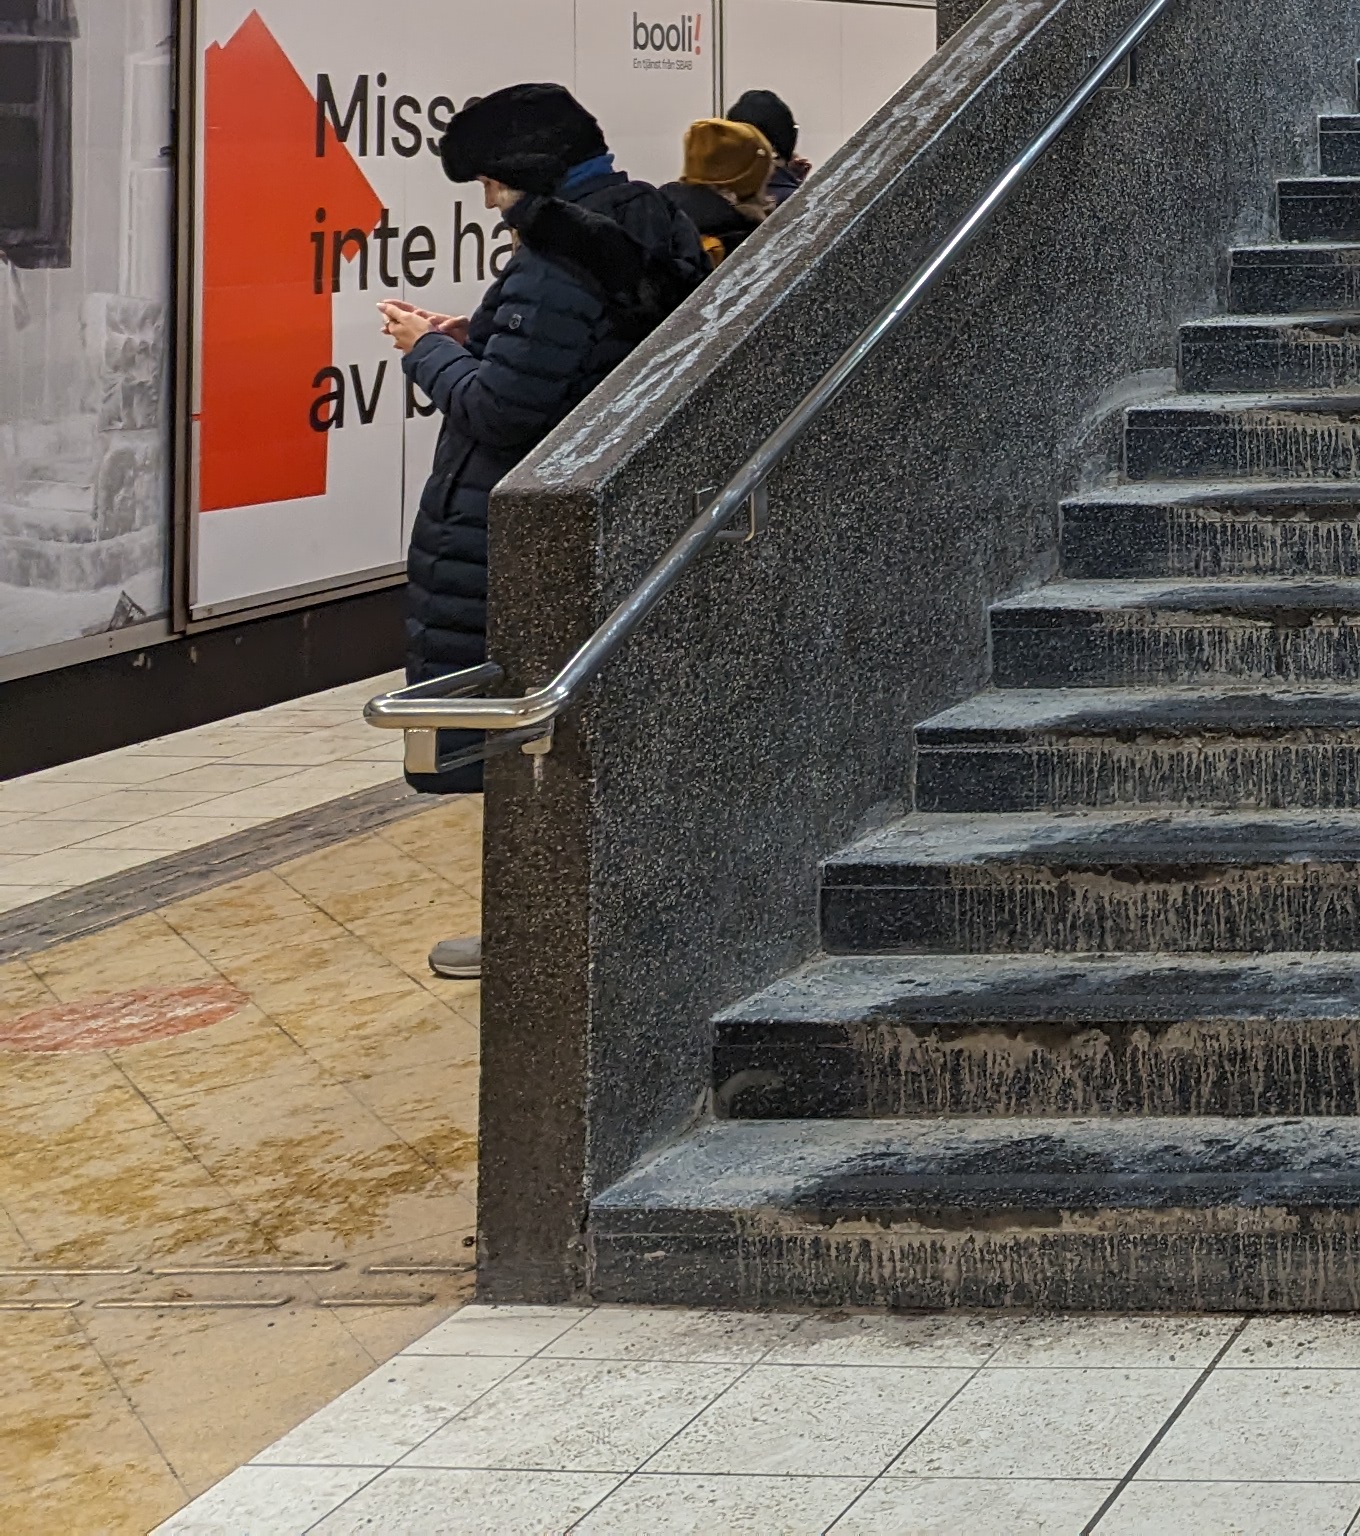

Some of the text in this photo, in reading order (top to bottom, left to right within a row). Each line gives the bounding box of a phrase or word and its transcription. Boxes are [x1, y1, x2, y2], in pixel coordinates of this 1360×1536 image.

[633, 11, 701, 56] booli!
[316, 72, 486, 157] Miss
[310, 206, 436, 295] inte
[309, 360, 388, 433] av
